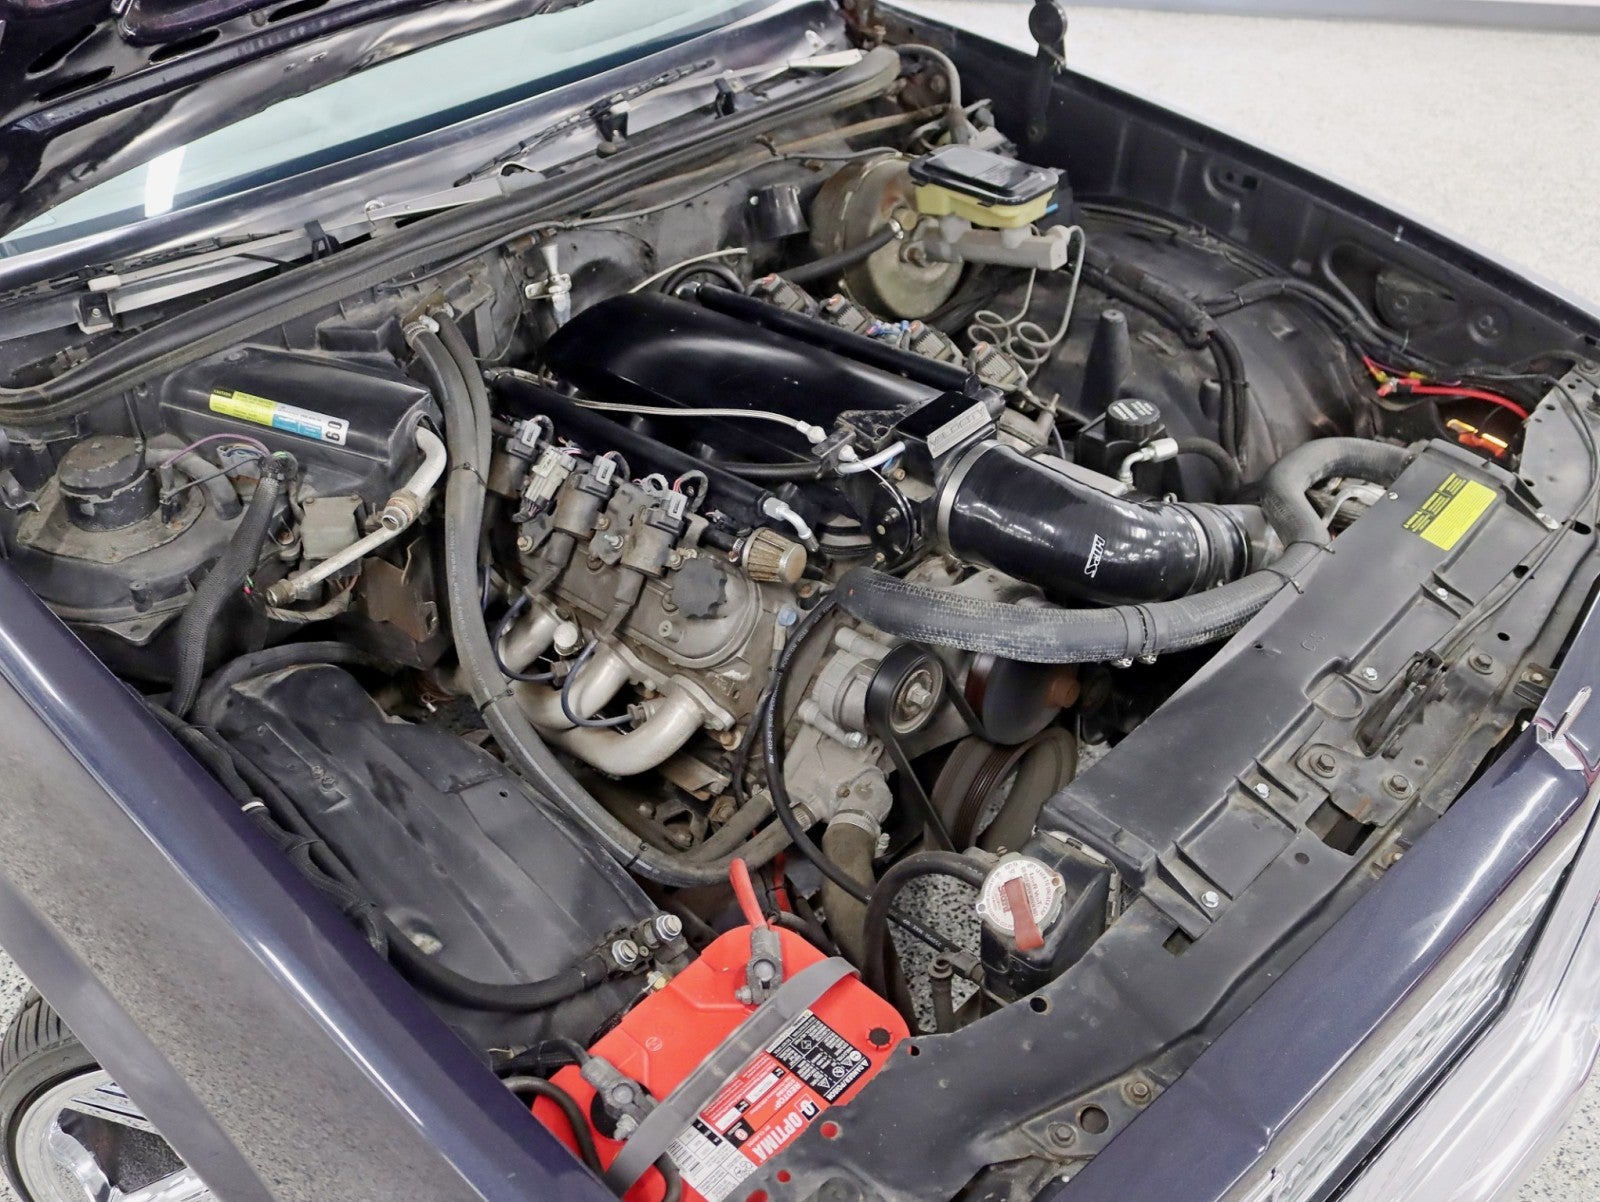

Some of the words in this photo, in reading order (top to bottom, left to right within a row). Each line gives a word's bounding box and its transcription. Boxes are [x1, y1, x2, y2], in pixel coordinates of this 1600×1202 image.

[1084, 533, 1106, 579] HPS
[773, 1081, 801, 1108] REDTOP
[751, 1110, 804, 1160] OPTIMA
